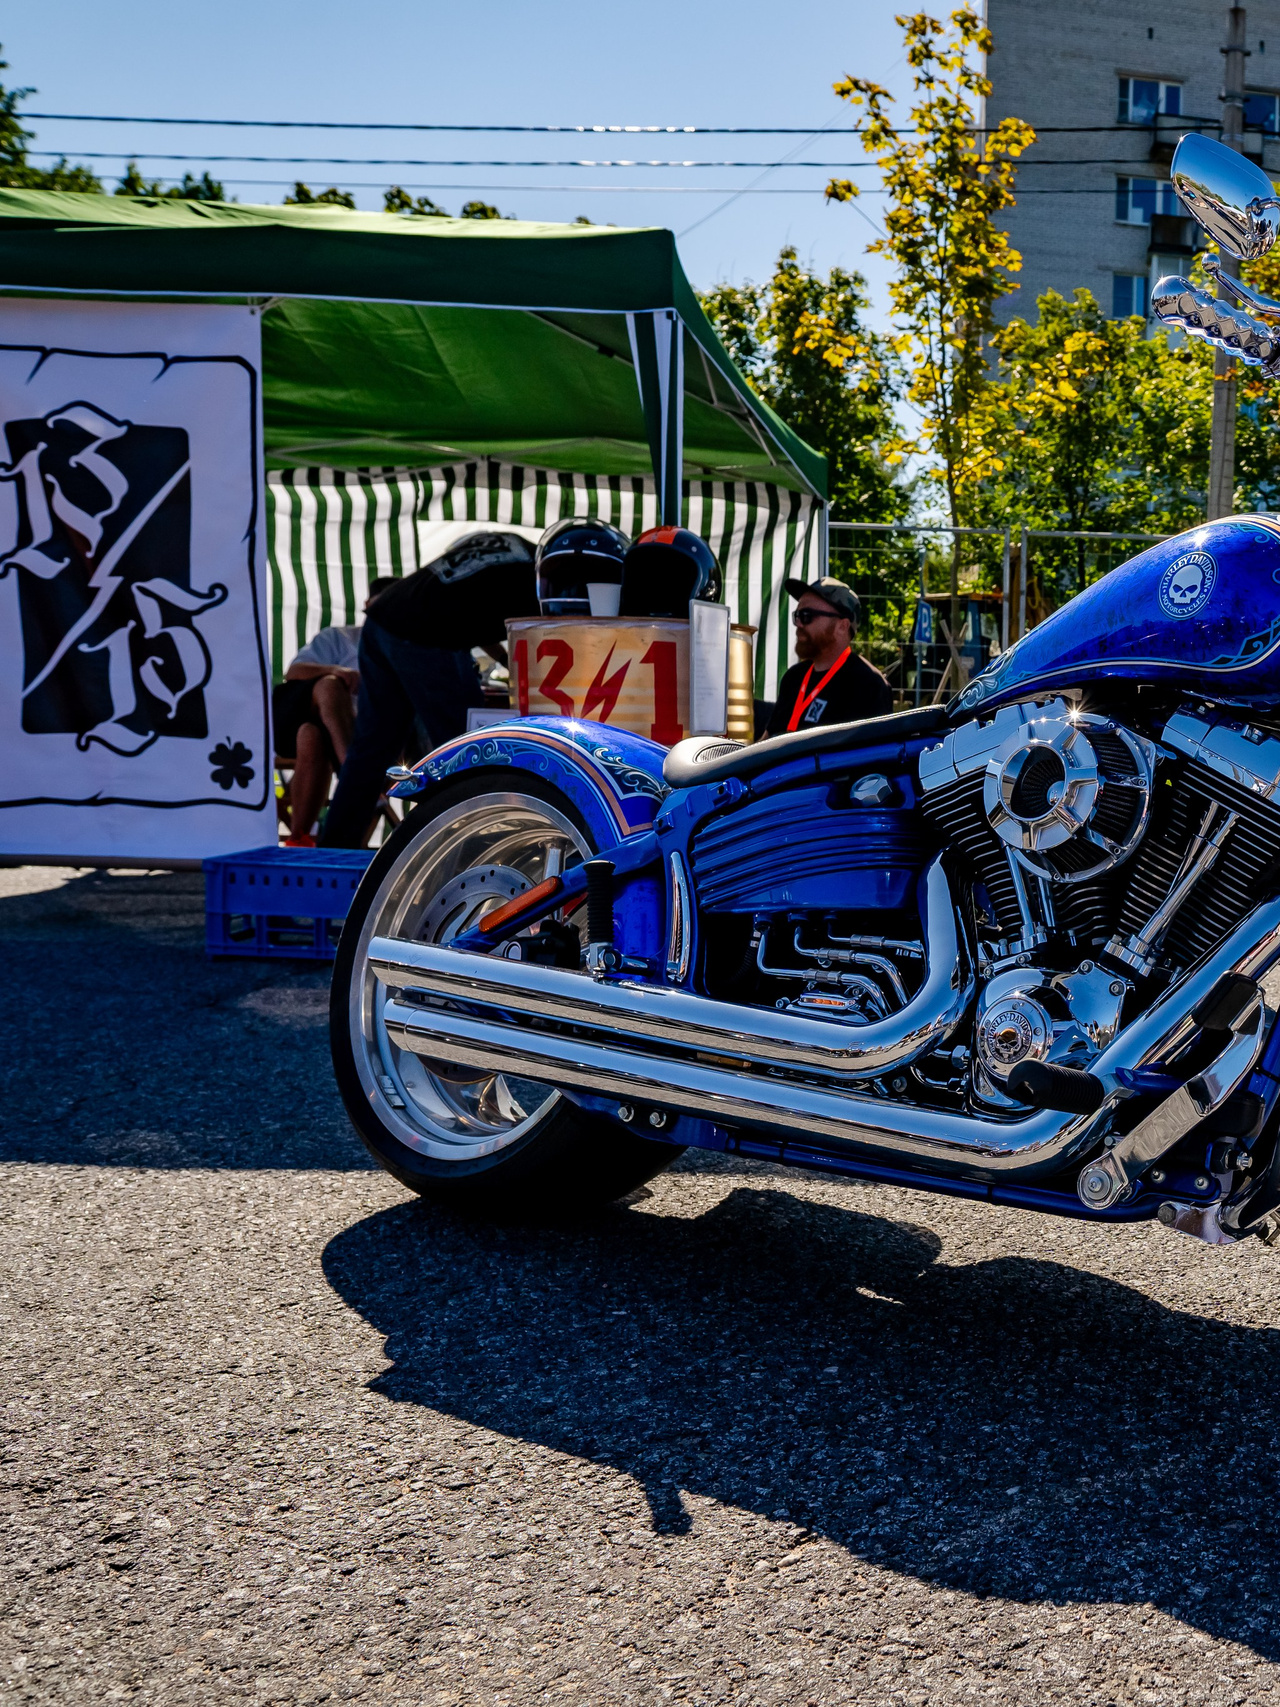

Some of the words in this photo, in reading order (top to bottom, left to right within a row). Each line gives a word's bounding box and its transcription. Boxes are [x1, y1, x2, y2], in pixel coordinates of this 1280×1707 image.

[1162, 555, 1191, 589] HARLEY
[1189, 554, 1213, 589] DAVIDSON
[1161, 593, 1206, 614] MOTORCYCLES
[512, 639, 575, 719] 13
